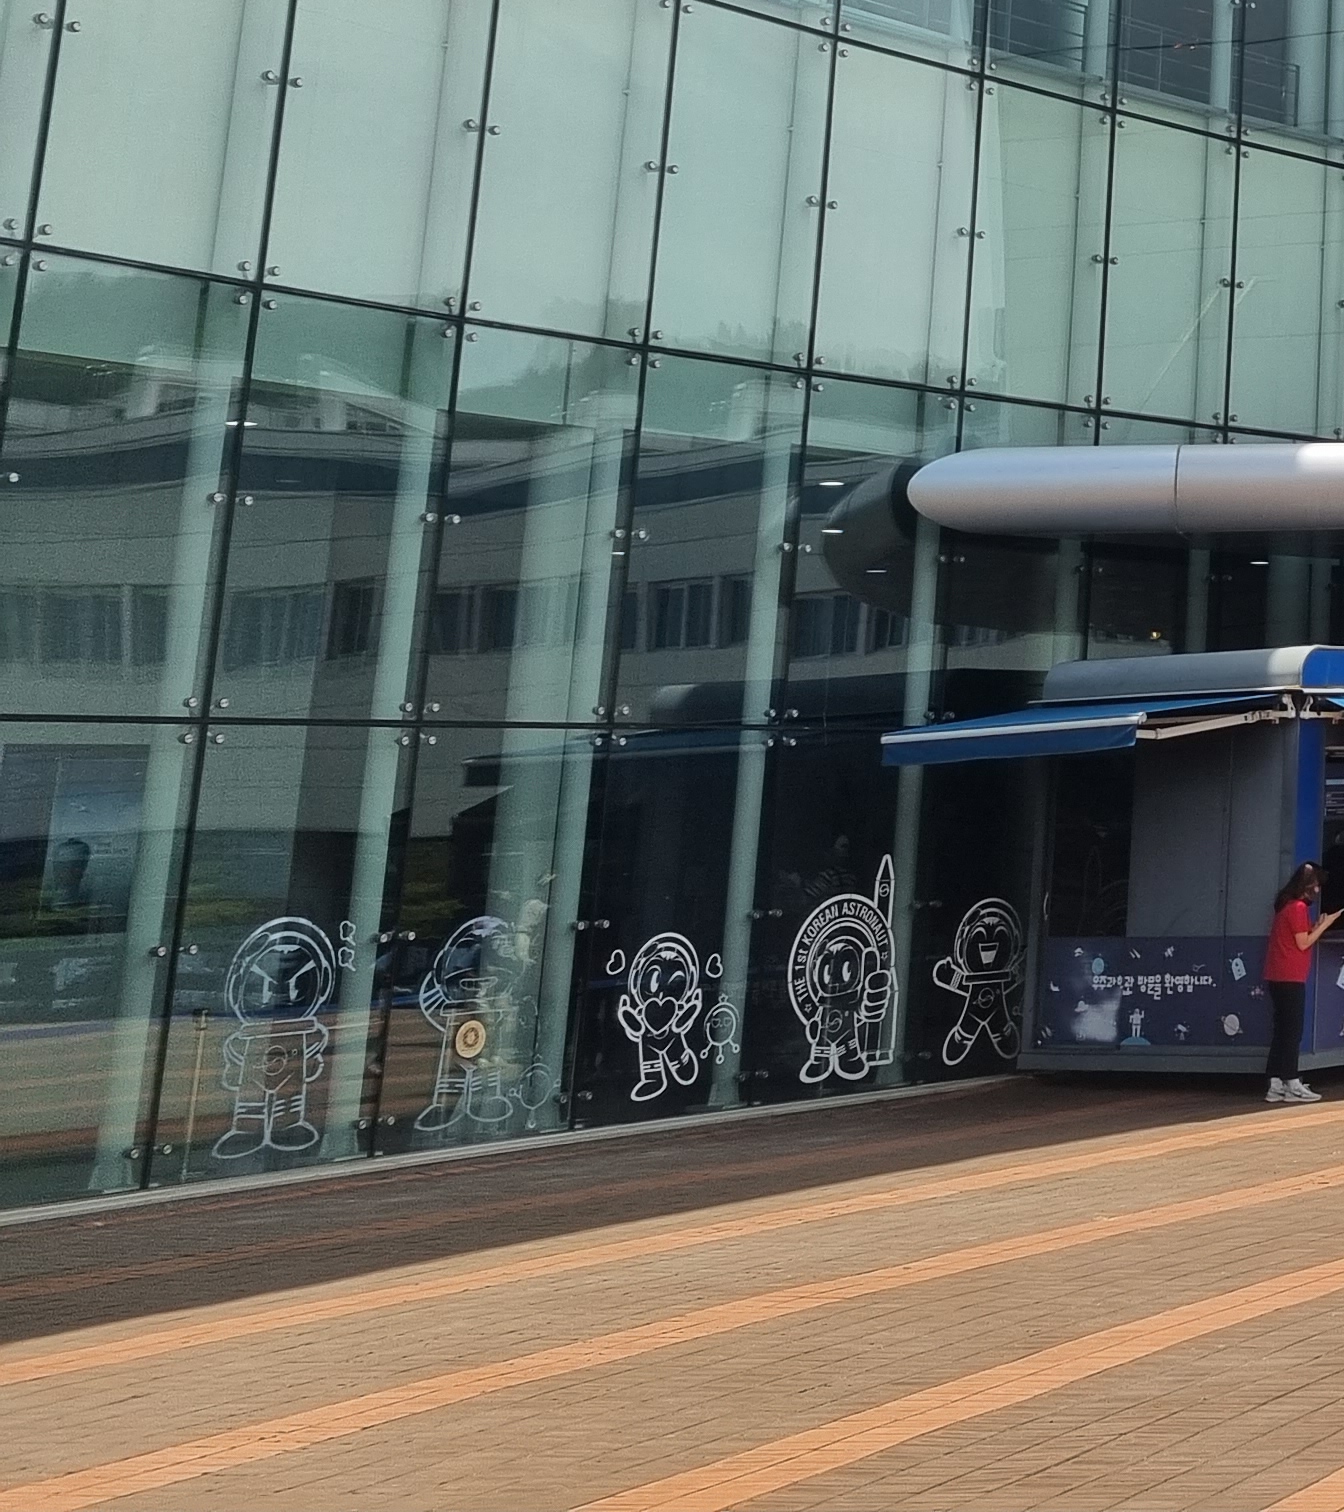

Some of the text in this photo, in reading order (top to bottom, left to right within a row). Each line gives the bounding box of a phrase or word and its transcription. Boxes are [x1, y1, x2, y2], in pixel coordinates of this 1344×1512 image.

[801, 904, 839, 946] KOREAN
[841, 901, 889, 947] ASTRONAUT
[794, 976, 809, 1003] THE
[1137, 974, 1162, 1000] 방문을
